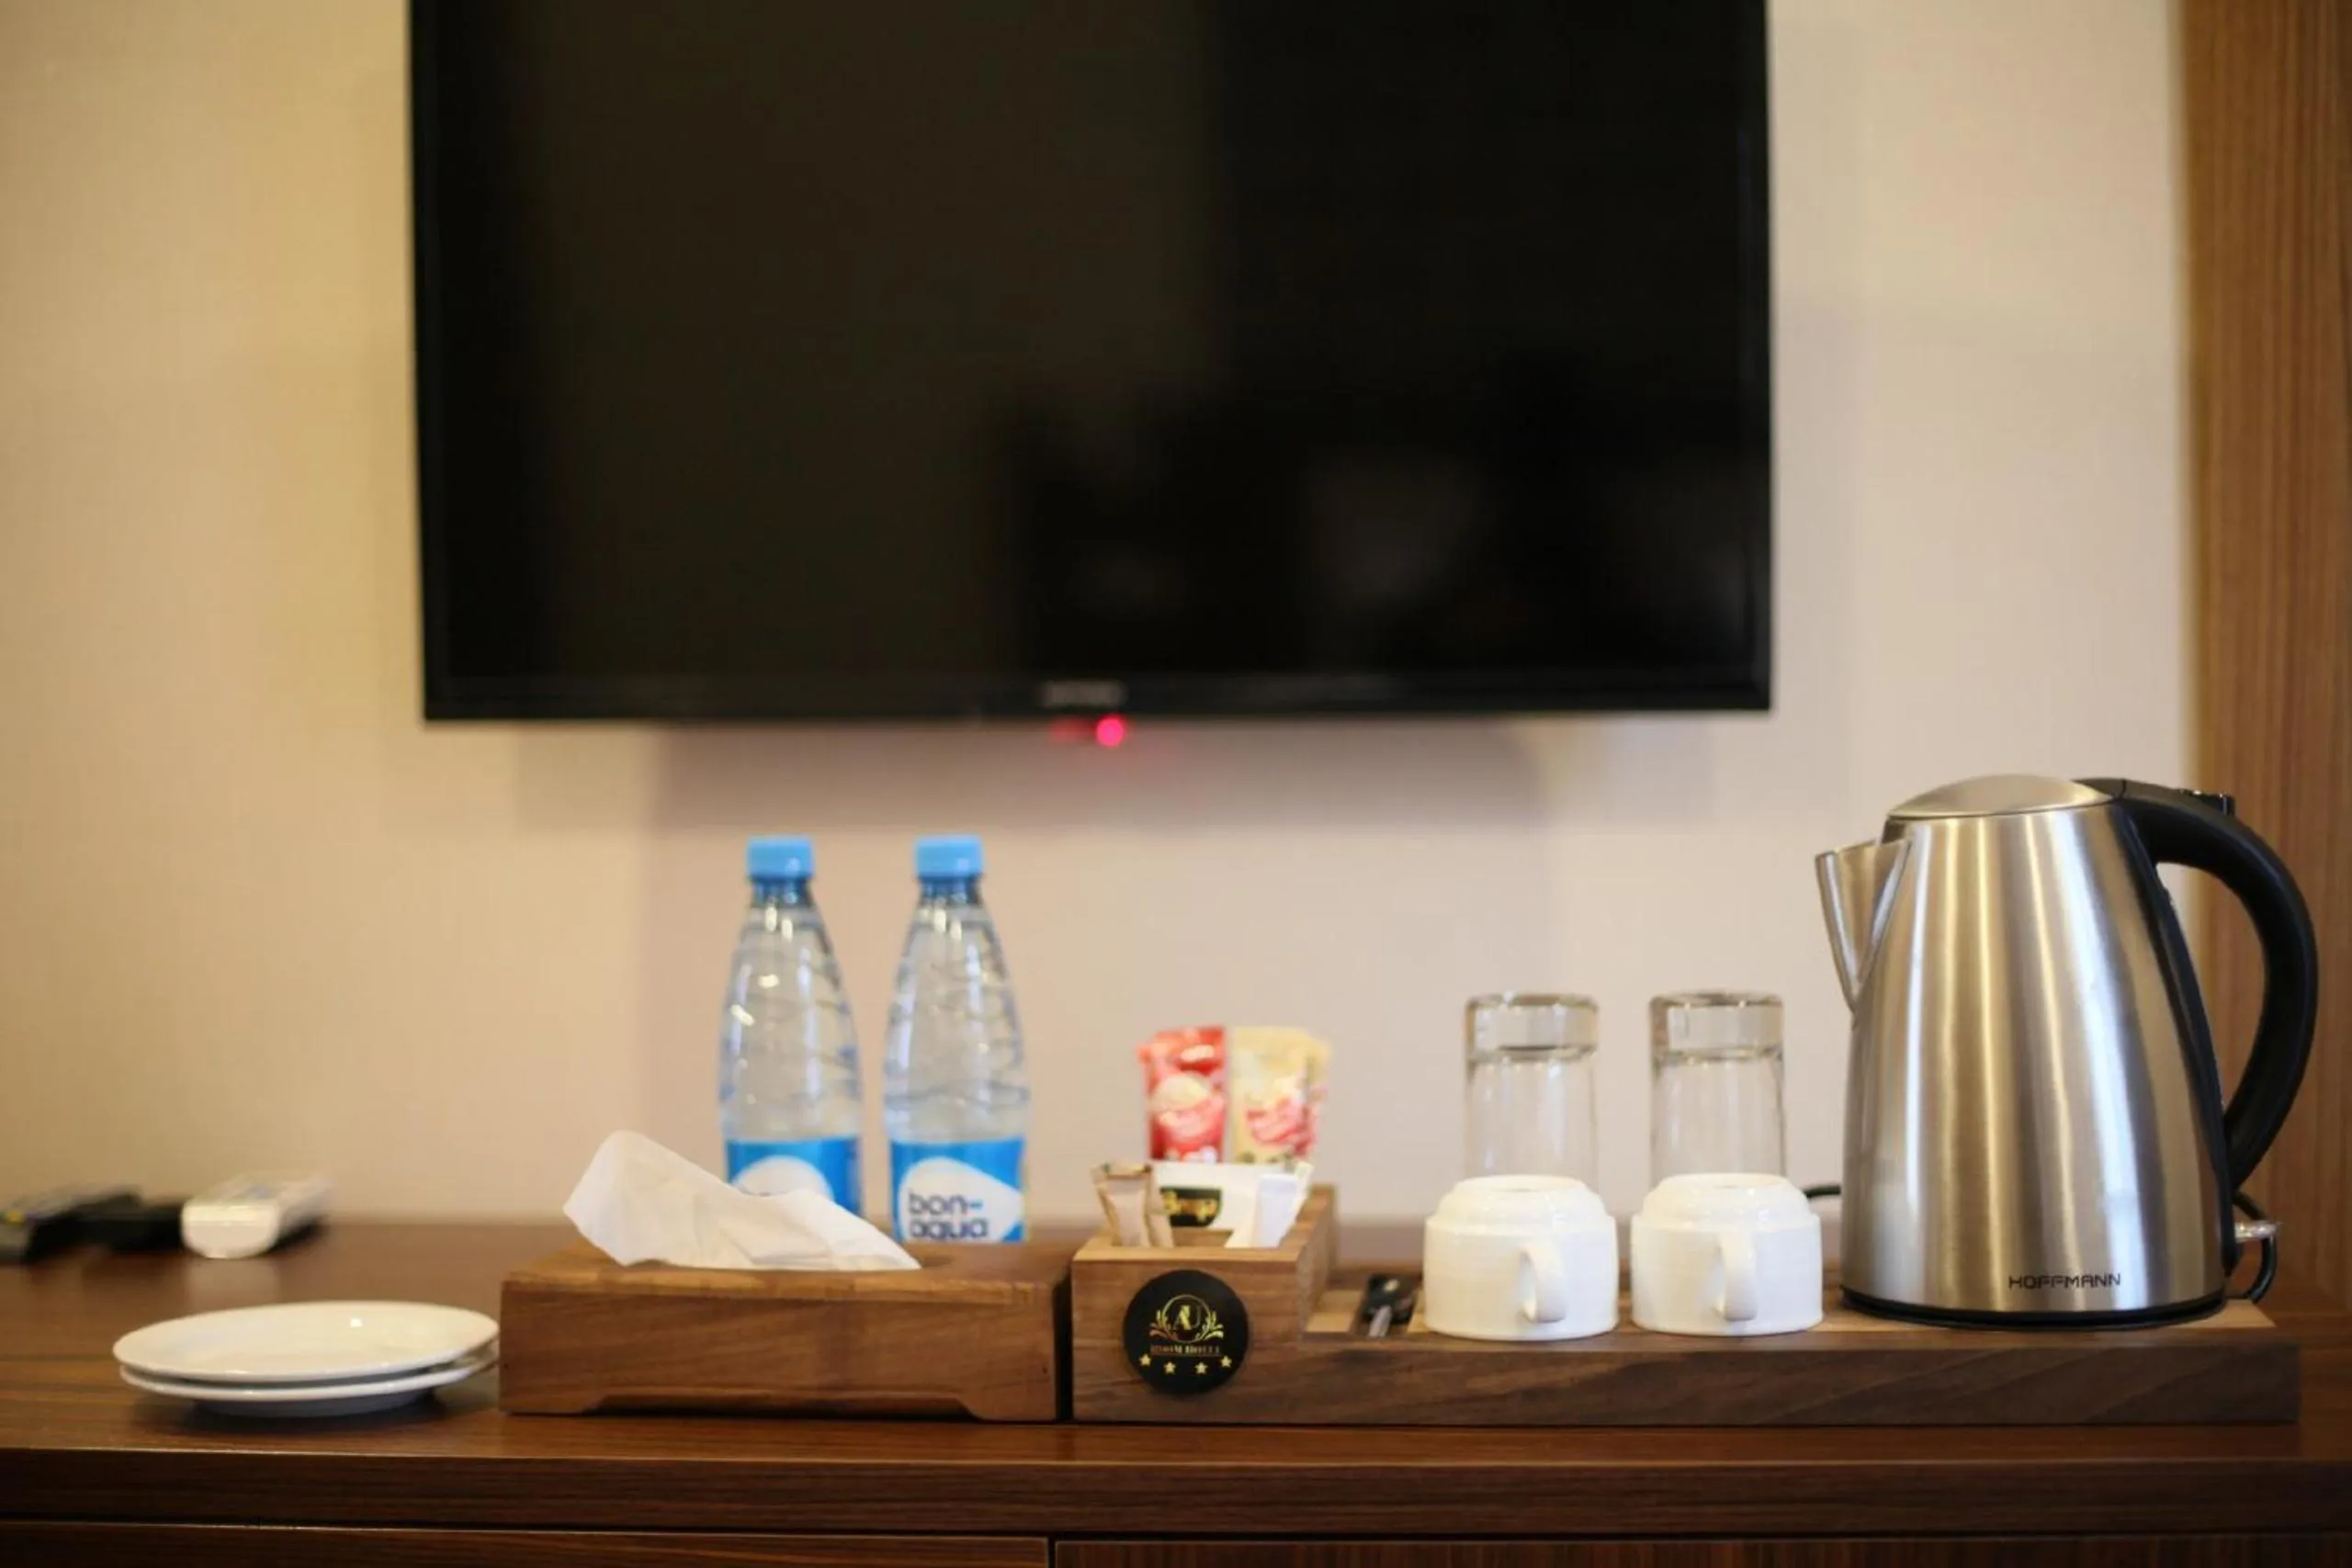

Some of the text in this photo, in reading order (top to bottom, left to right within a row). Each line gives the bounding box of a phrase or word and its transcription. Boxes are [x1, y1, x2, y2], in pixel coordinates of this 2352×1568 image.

[909, 1189, 984, 1214] bon-
[910, 1218, 989, 1239] aqua
[2008, 1273, 2120, 1289] HOFFMANN
